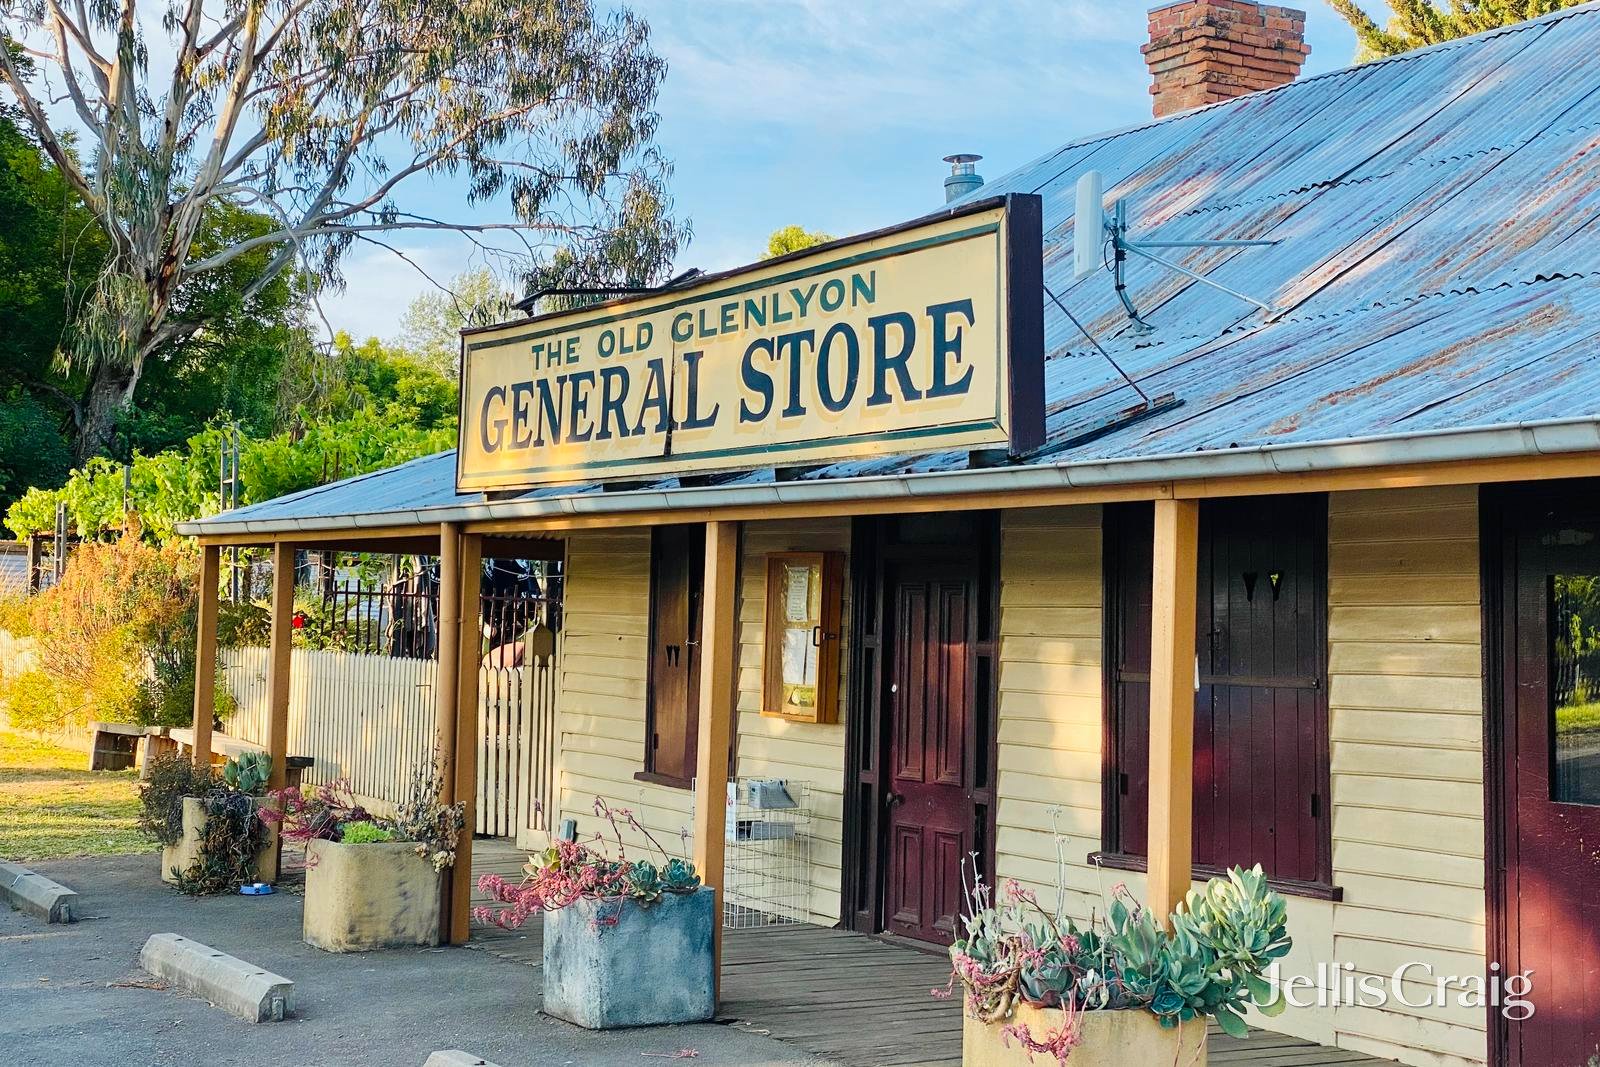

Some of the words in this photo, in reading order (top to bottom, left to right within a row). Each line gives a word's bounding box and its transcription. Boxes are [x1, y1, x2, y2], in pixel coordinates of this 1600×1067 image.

[482, 350, 720, 453] GENERAL
[740, 298, 975, 423] STORE
[532, 336, 580, 370] THE
[598, 322, 653, 358] OLD
[671, 270, 876, 343] GLENLYON
